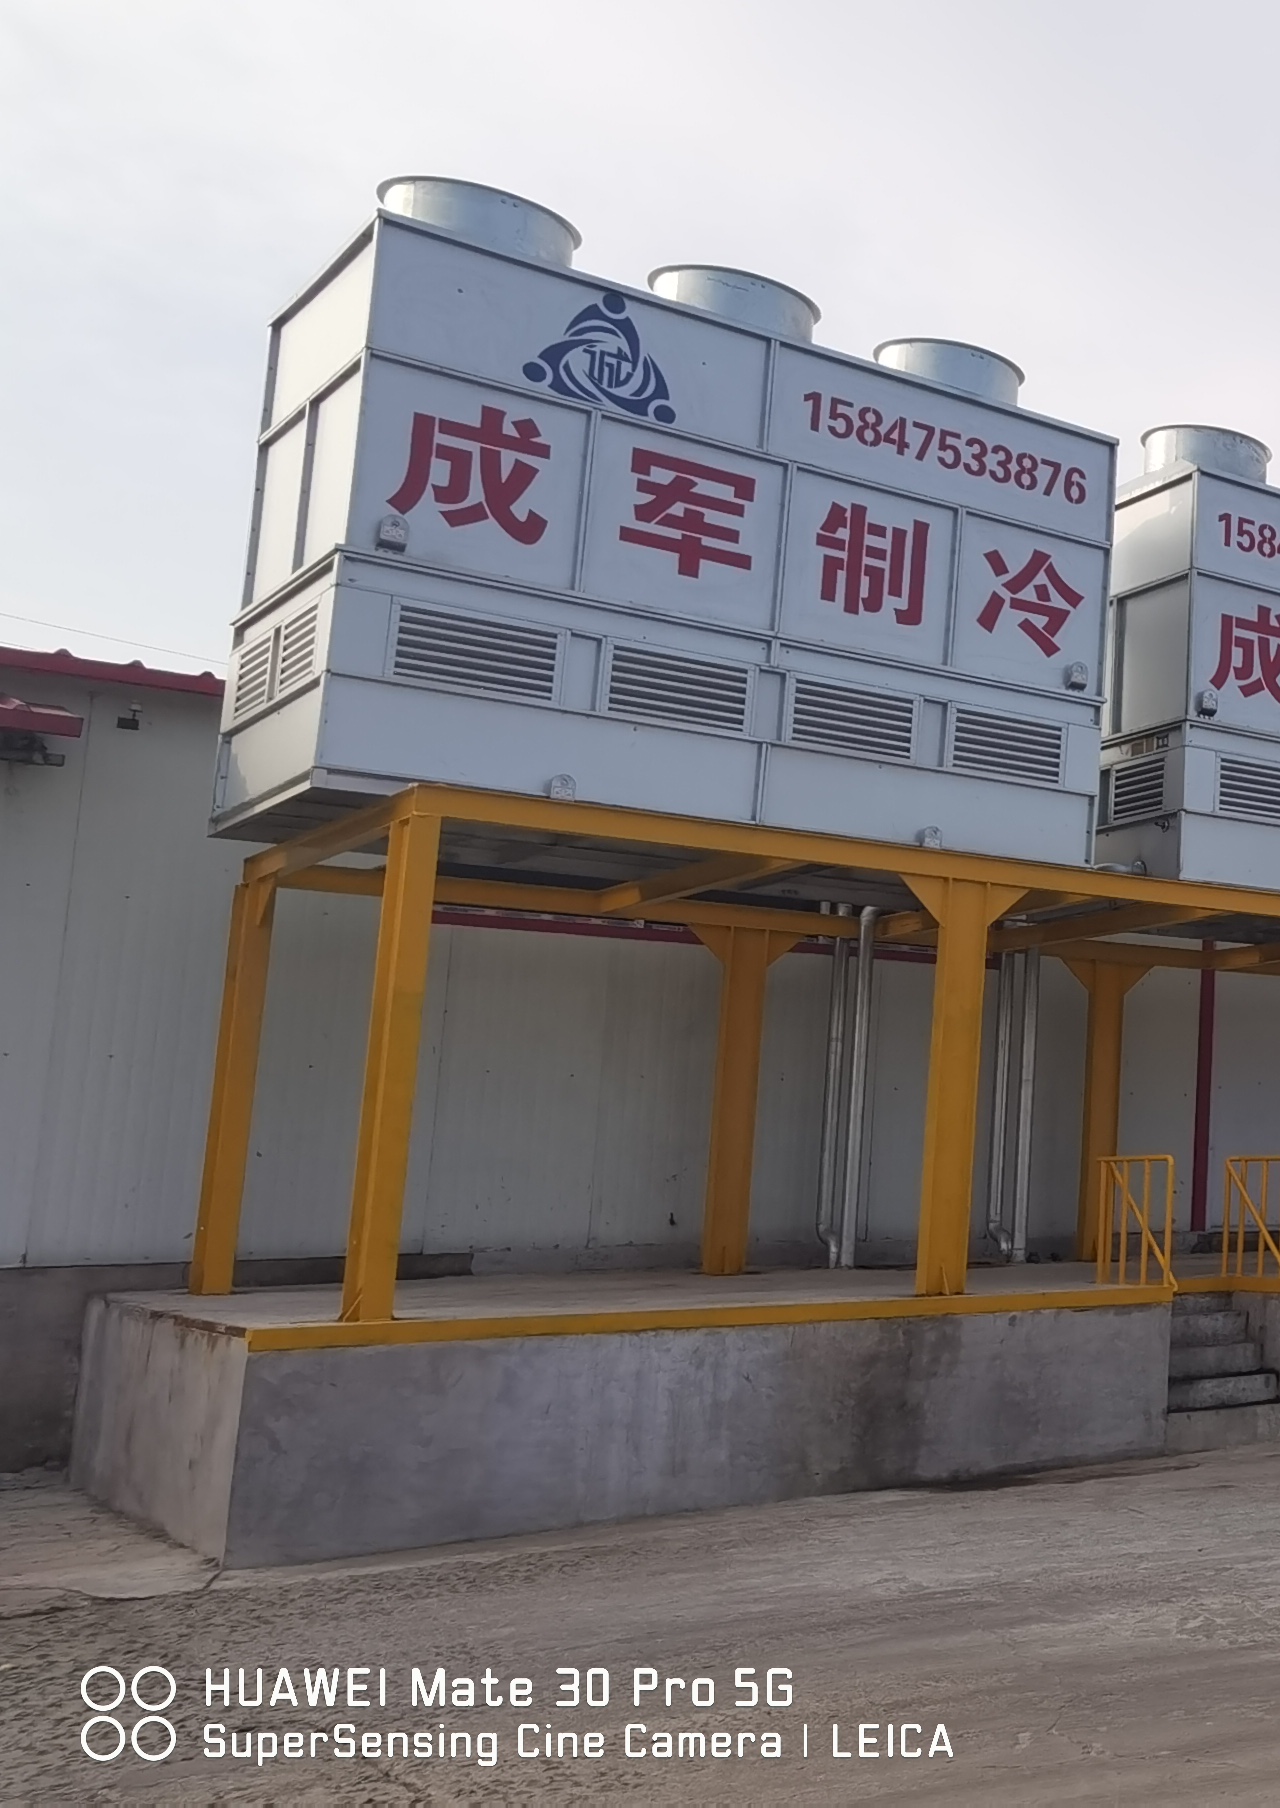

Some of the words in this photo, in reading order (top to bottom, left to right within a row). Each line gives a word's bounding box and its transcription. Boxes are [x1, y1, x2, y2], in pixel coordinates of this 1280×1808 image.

[387, 405, 1085, 658] 成军制冷
[803, 390, 1087, 506] 15847533876
